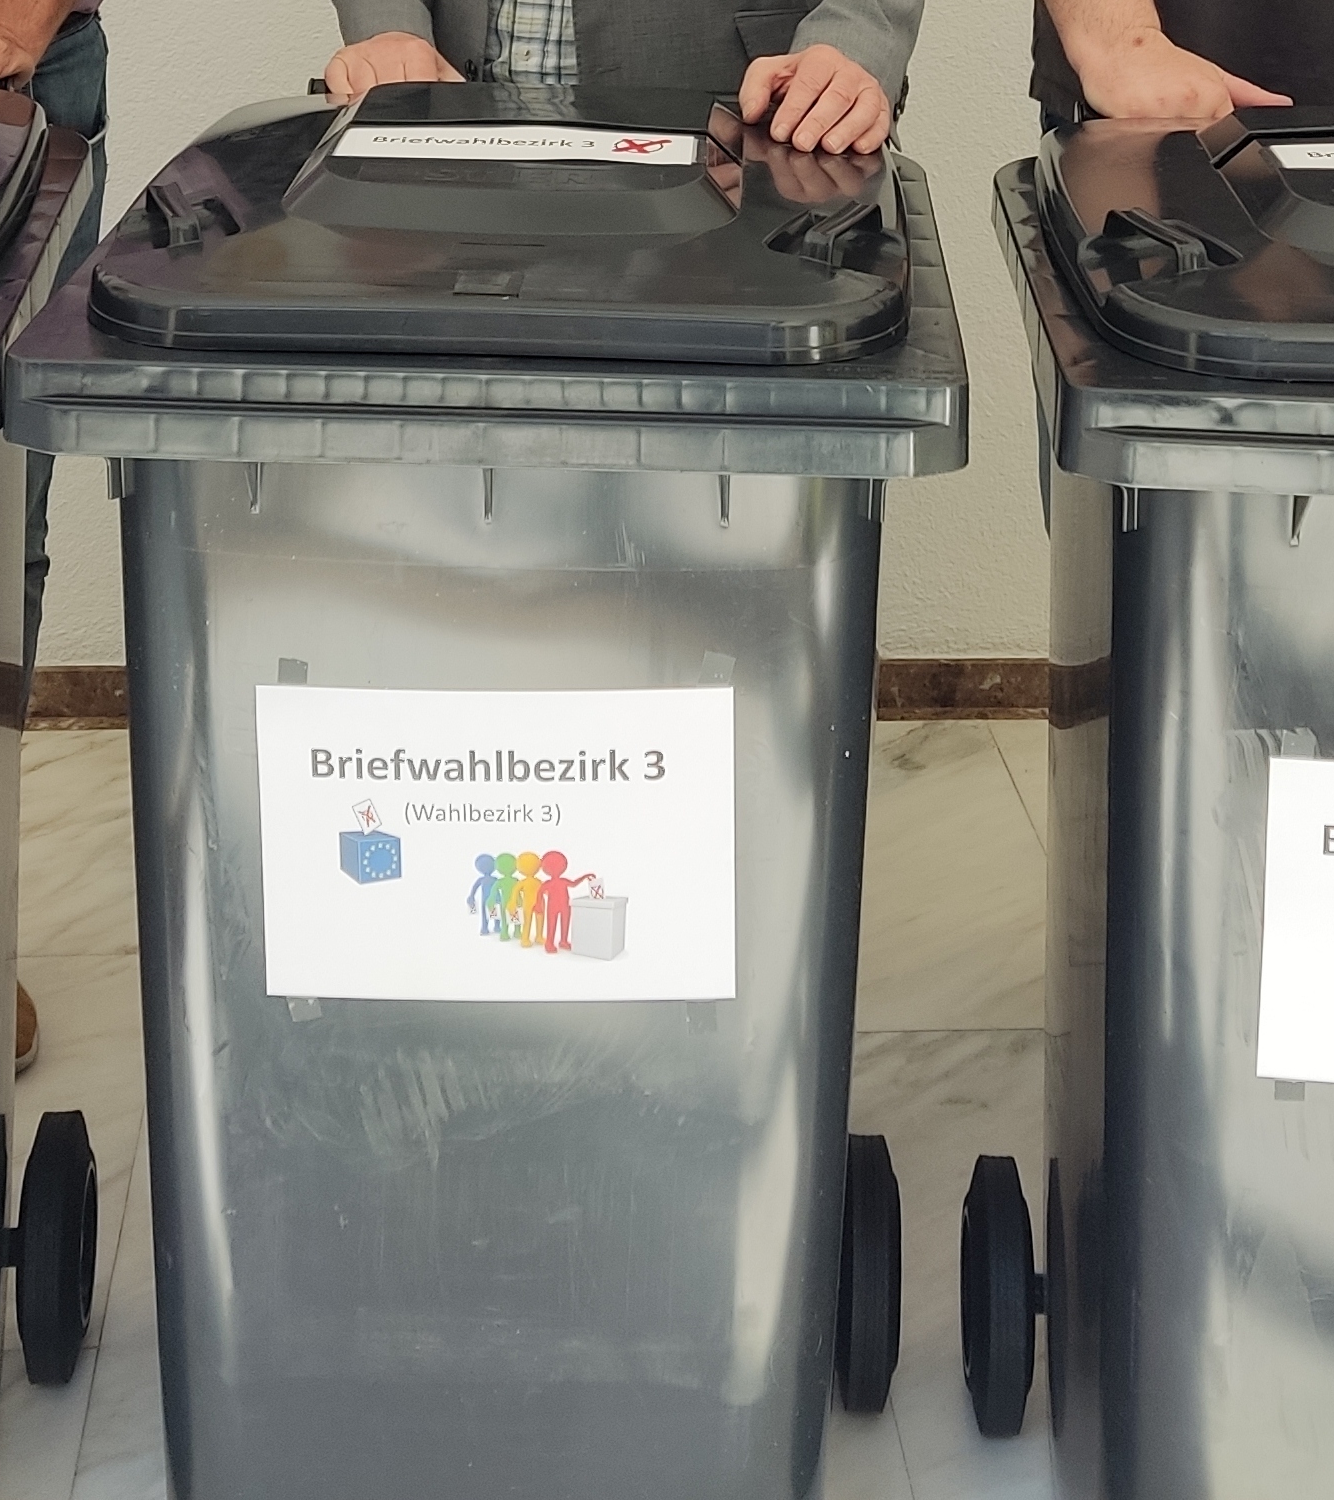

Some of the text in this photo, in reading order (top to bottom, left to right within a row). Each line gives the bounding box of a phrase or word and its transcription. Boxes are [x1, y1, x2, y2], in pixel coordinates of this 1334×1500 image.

[372, 135, 597, 148] Briefwahlbezirk 3
[310, 747, 667, 783] Briefwahlbezirk 3
[403, 801, 563, 826] (Wahlbezirk 3)
